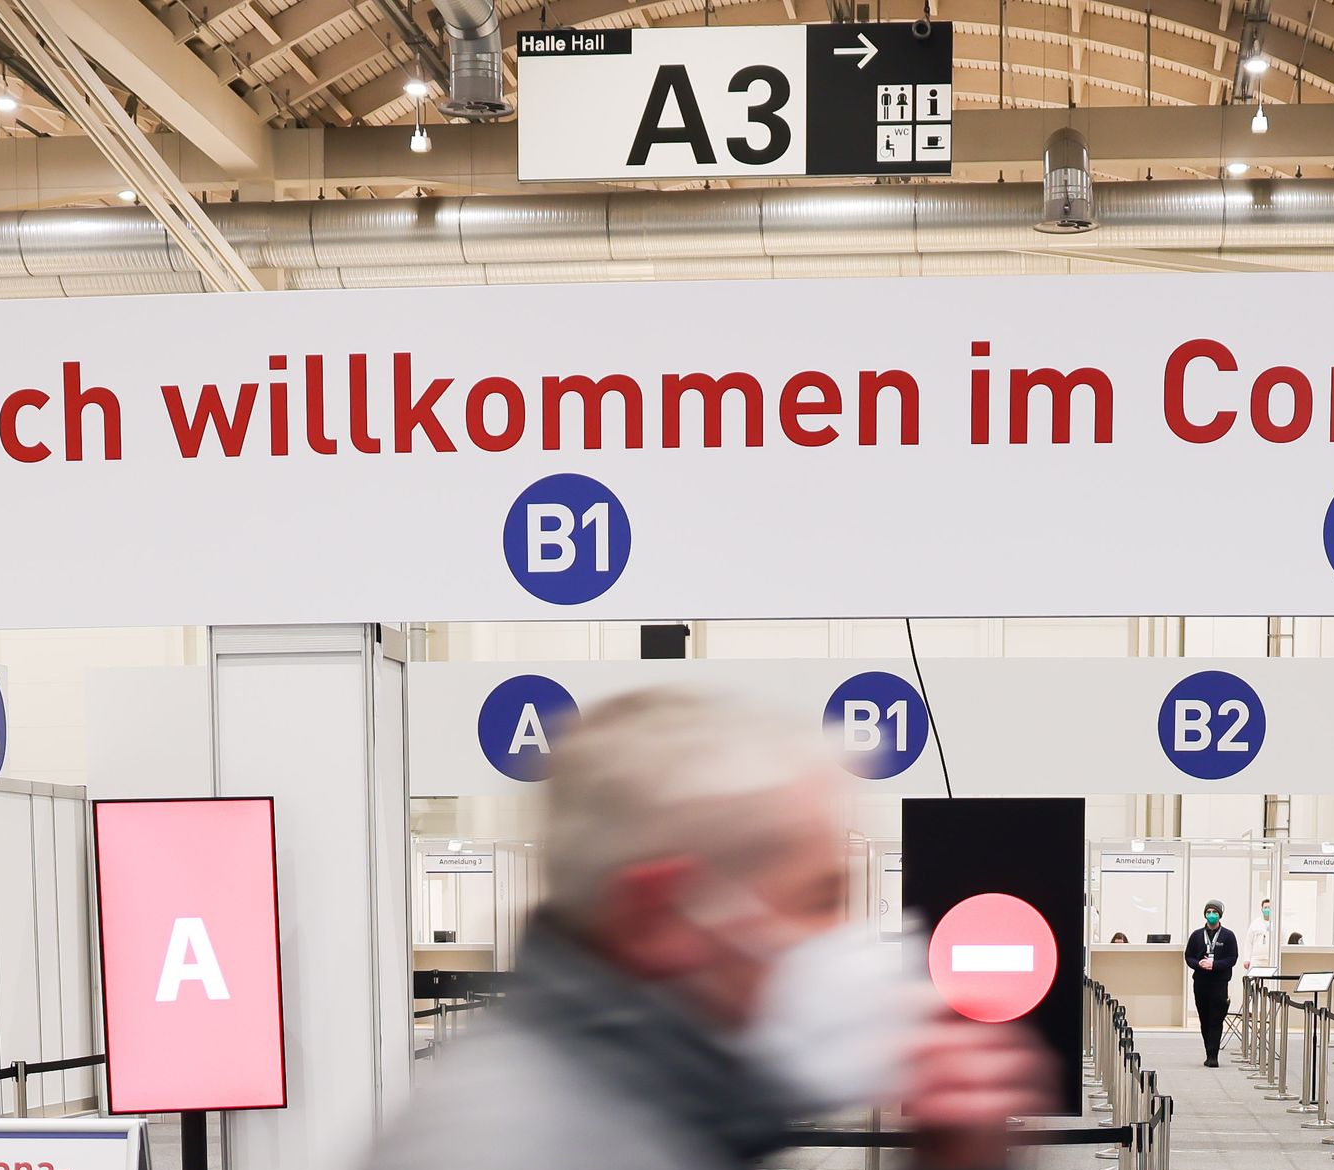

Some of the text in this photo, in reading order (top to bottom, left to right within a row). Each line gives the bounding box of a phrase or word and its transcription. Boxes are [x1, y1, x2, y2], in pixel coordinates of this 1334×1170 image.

[521, 34, 605, 53] Halle Hall
[625, 64, 792, 166] A3
[894, 128, 909, 136] WC
[161, 352, 919, 458] willkommen
[971, 341, 1113, 444] im
[527, 503, 609, 572] B1
[508, 703, 551, 754] A
[843, 700, 908, 752] B1
[1175, 700, 1249, 751] B2
[1115, 857, 1154, 865] Anmeldung
[155, 917, 231, 1002] A
